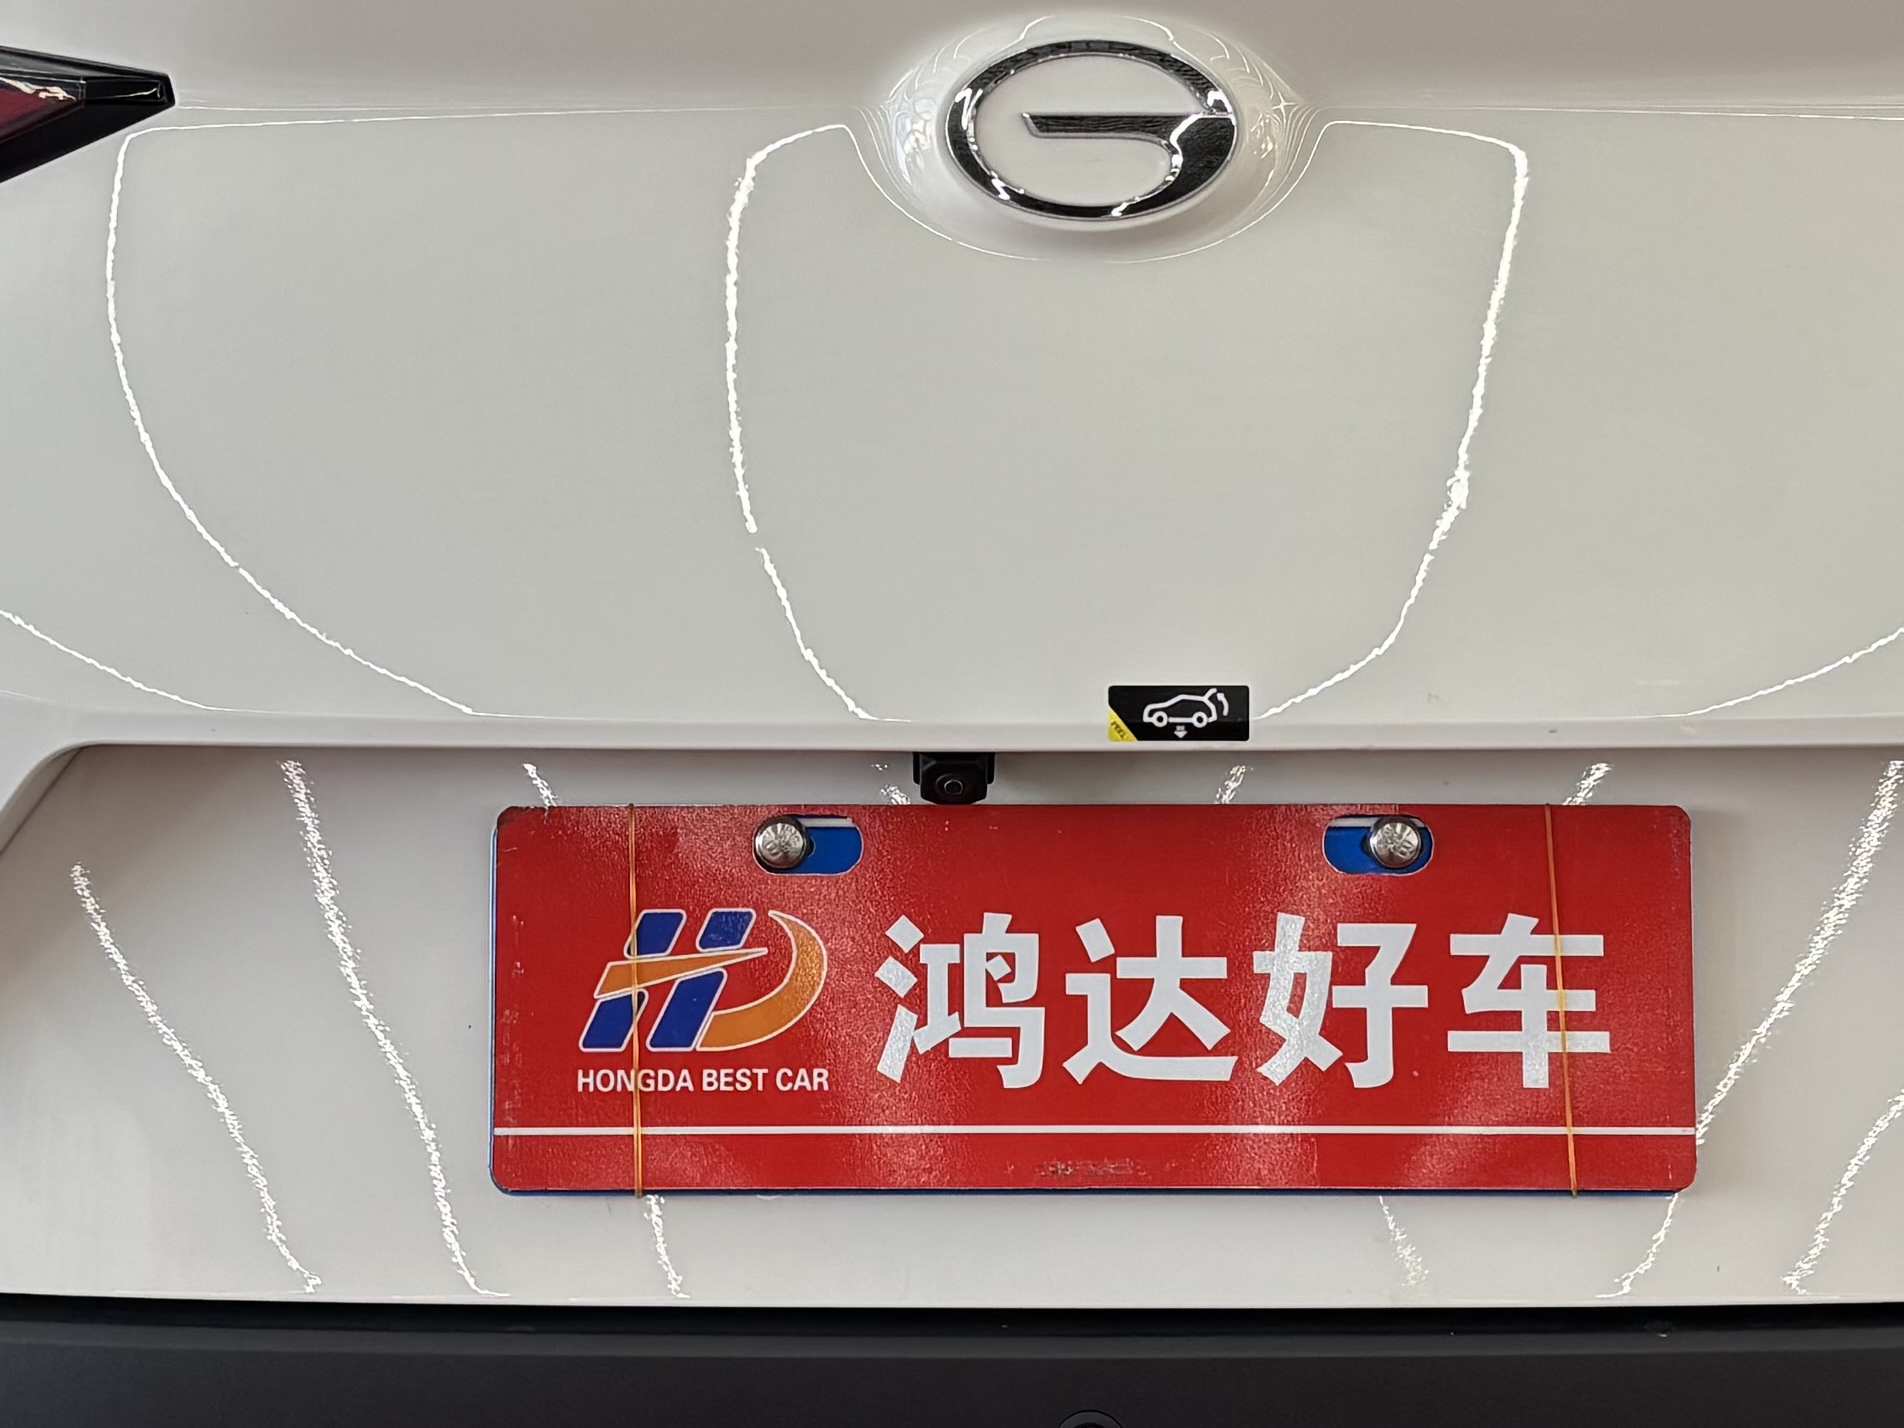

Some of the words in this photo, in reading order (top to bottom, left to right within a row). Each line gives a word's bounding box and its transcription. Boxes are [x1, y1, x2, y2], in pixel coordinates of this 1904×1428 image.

[875, 912, 1611, 1088] 鸿达好车
[577, 1068, 694, 1093] HONGDA
[702, 1068, 769, 1092] BEST
[775, 1067, 830, 1091] CAR
